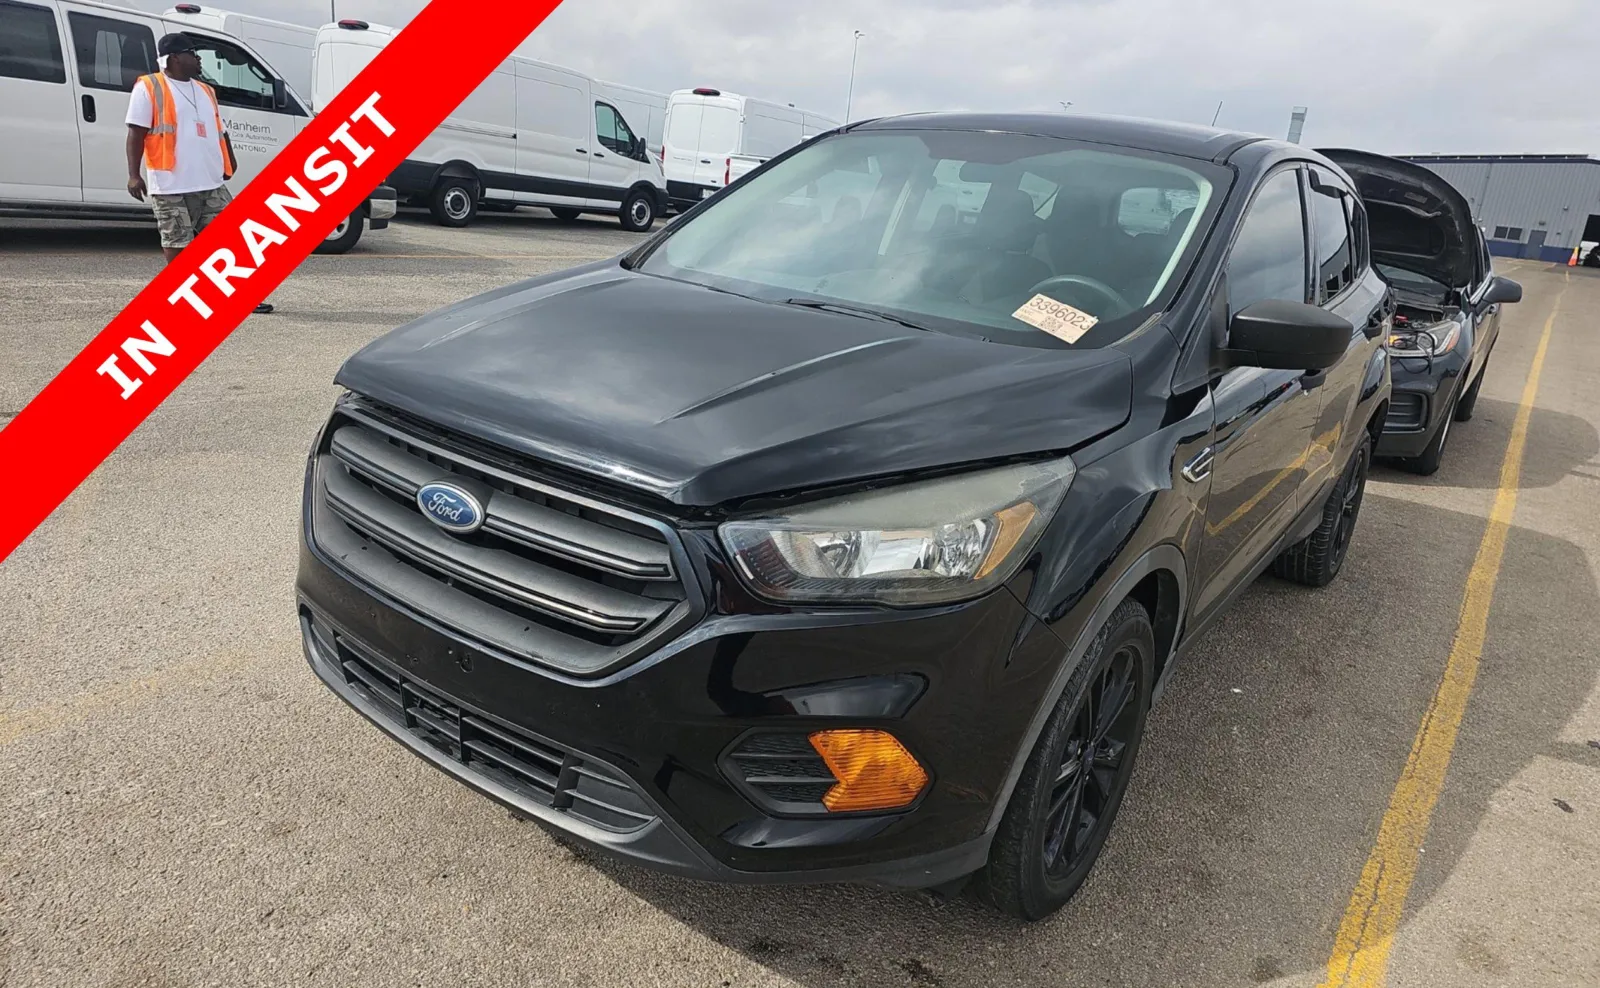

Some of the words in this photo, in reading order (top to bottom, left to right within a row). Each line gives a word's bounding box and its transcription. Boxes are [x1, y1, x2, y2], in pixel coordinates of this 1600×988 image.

[223, 119, 271, 134] Manheim
[246, 133, 278, 143] Automotive
[233, 143, 267, 153] ANTONIO
[428, 492, 463, 521] Ford
